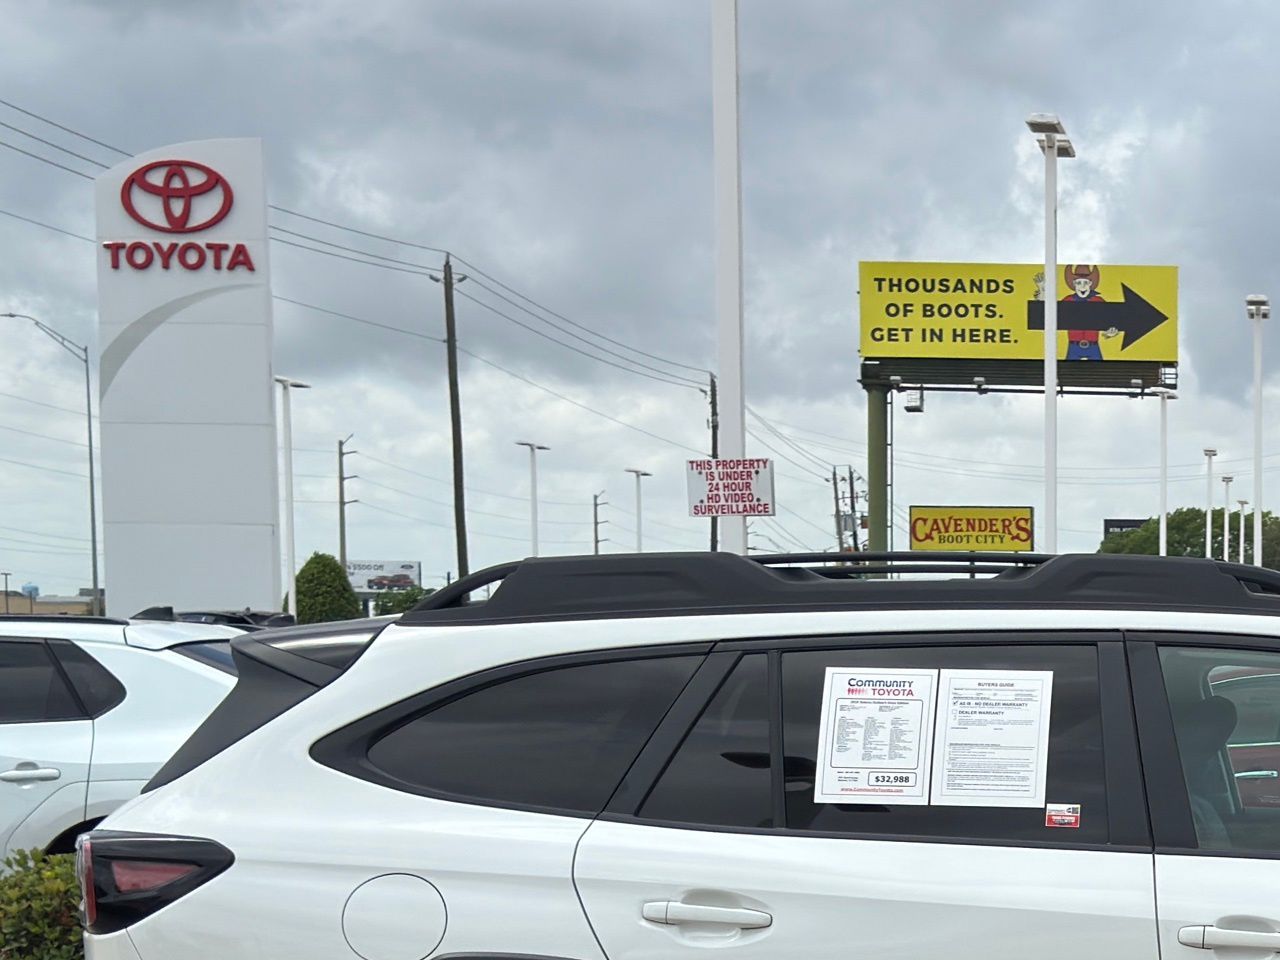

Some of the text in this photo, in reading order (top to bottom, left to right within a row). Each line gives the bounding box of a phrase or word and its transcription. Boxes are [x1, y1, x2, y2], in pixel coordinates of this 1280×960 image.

[103, 241, 255, 271] TOYOTA
[874, 278, 1015, 294] THOUSANDS
[885, 303, 1004, 318] OF BOOTS.
[870, 328, 1018, 343] GET IN HERE.
[689, 459, 769, 470] THIS PROPERTY
[705, 471, 752, 481] IS UNDER
[708, 482, 752, 492] 24 HOUR
[706, 493, 754, 503] HD VIDEO
[693, 504, 770, 515] SURVEILLANCE
[911, 516, 1032, 542] CAVENDER'S
[938, 534, 1006, 544] BOOT CITY
[871, 688, 914, 696] TOYOTA
[875, 775, 910, 784] $32,988
